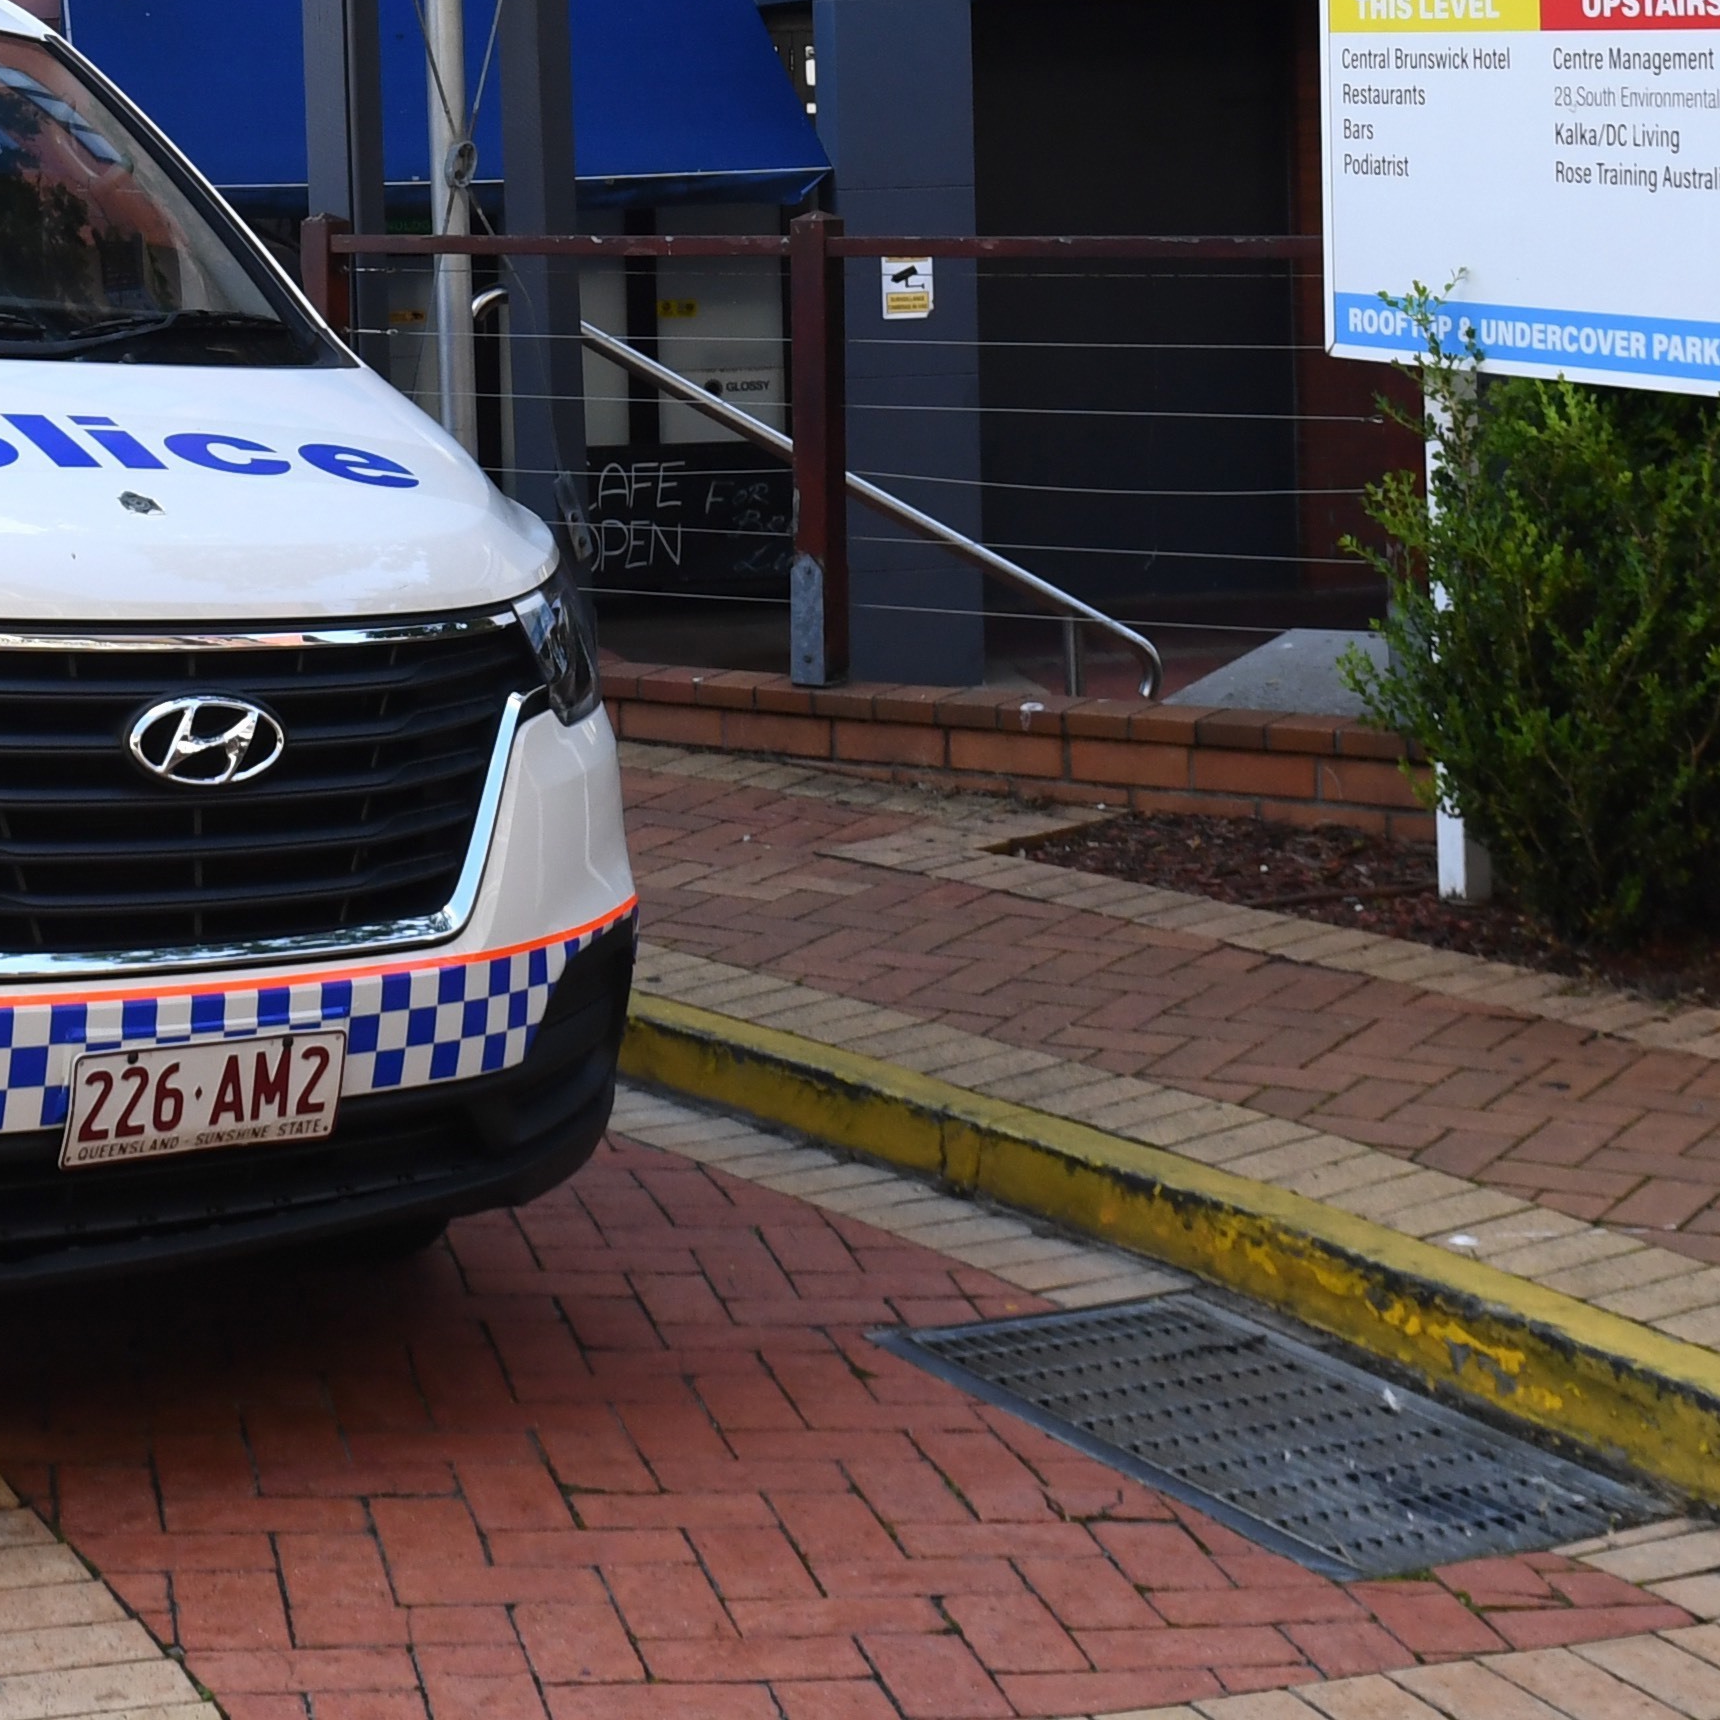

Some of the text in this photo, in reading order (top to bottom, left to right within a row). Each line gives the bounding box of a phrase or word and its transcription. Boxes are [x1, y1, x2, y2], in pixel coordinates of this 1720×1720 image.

[1342, 47, 1511, 70] Central Brunswick Hotel
[1553, 47, 1715, 76] Centre Management
[1342, 83, 1426, 106] Restaurants
[1554, 85, 1720, 110] 28 South Environmental
[1343, 118, 1374, 140] Bars
[1554, 122, 1681, 154] Kalka/DC Living
[1344, 153, 1410, 177] Podiatrist
[1555, 160, 1592, 184] Rose
[1596, 162, 1658, 193] Training
[1480, 318, 1647, 360] UNDERCOVER
[726, 381, 770, 393] GLOSSY
[587, 460, 686, 511] AFE
[77, 1136, 180, 1161] QUEENSLAND
[194, 1125, 271, 1146] SUNSHINE
[279, 1119, 323, 1137] STATE
